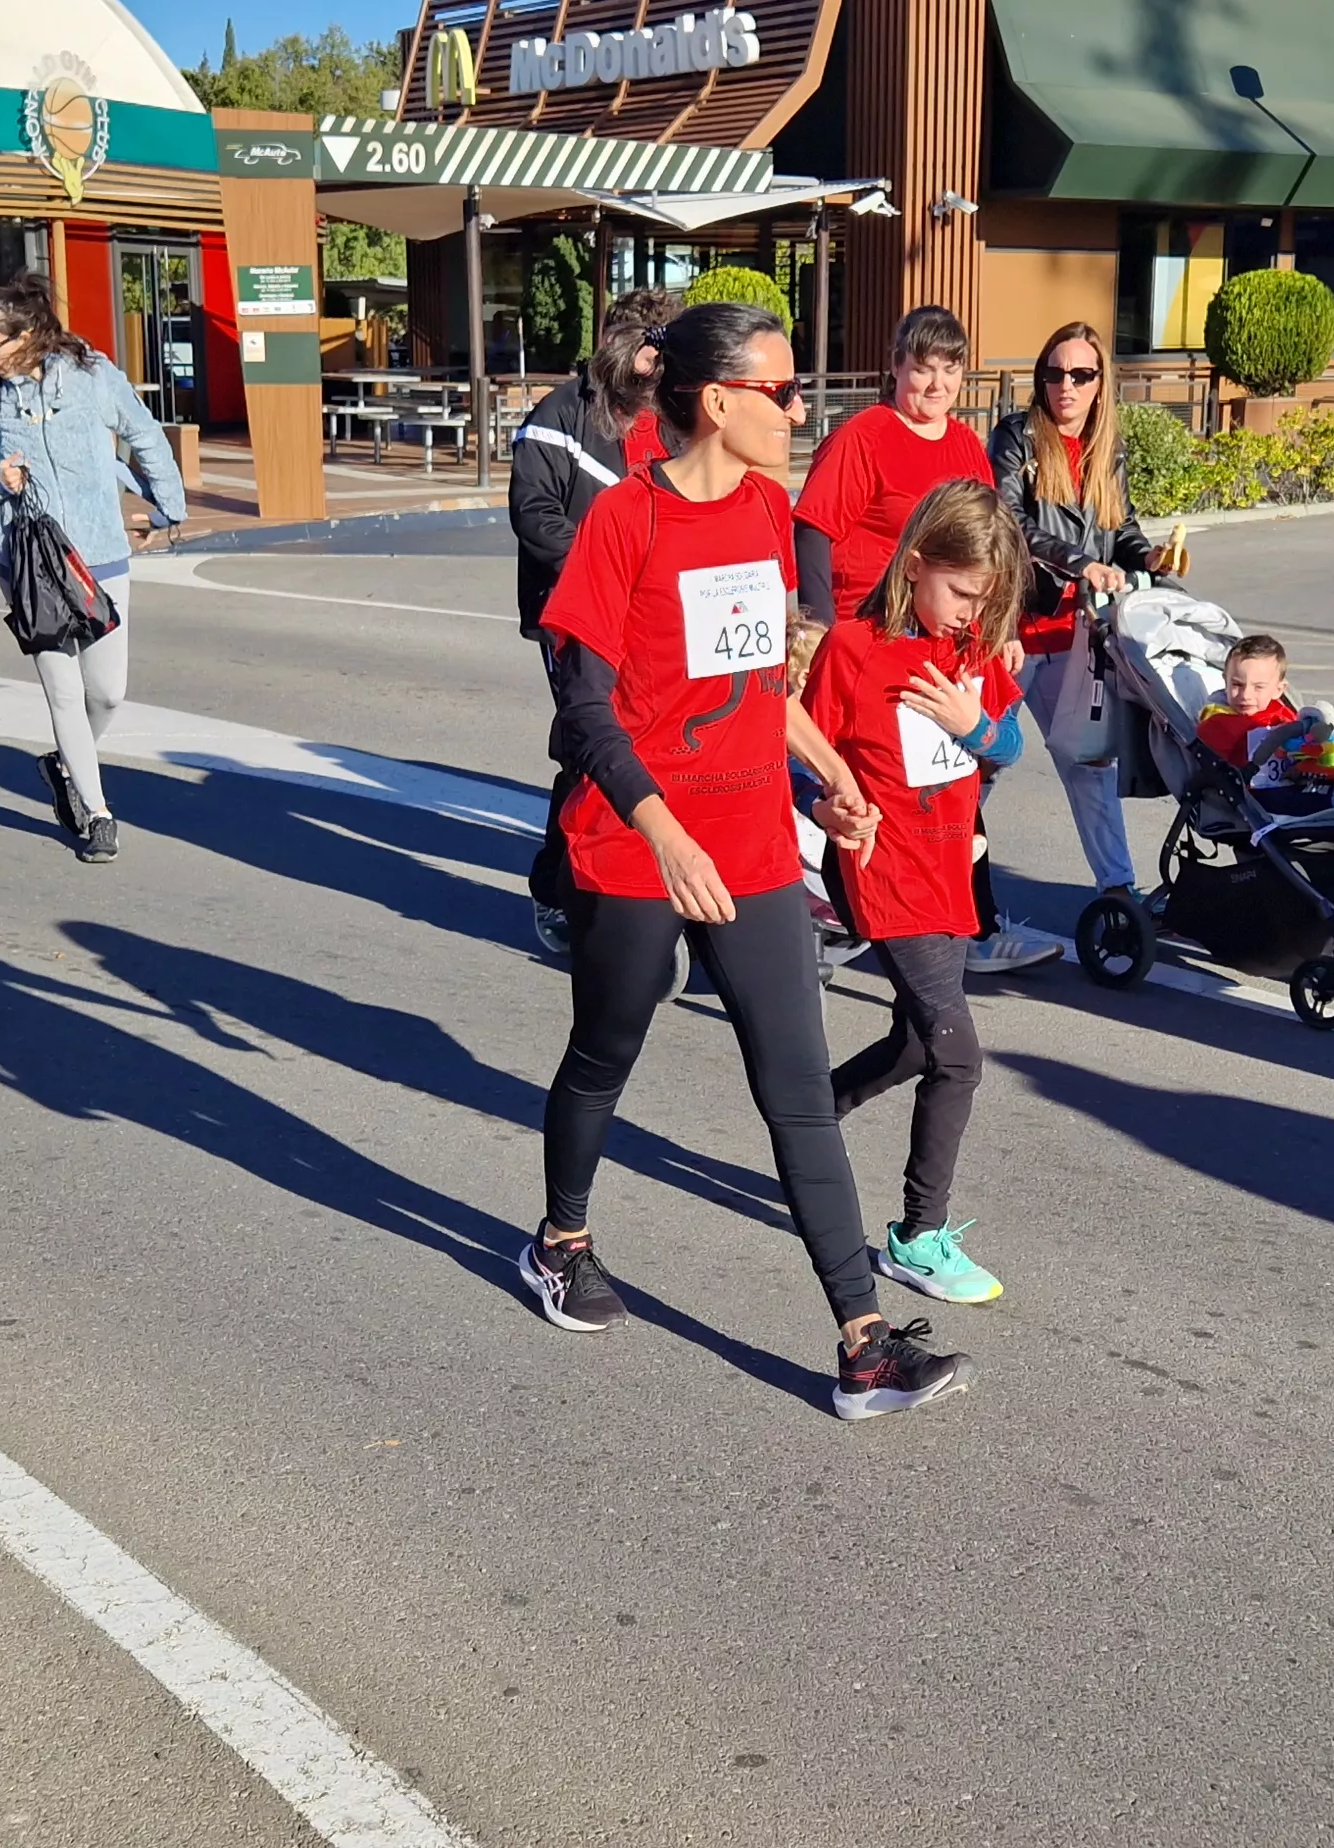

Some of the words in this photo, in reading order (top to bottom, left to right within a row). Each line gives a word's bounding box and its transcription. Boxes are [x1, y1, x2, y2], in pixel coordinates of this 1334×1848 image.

[509, 7, 760, 94] McDonald's
[91, 98, 110, 165] CLUB
[366, 141, 426, 174] 2.60
[714, 620, 773, 660] 428
[931, 740, 974, 770] 42
[682, 773, 723, 783] MARCHA
